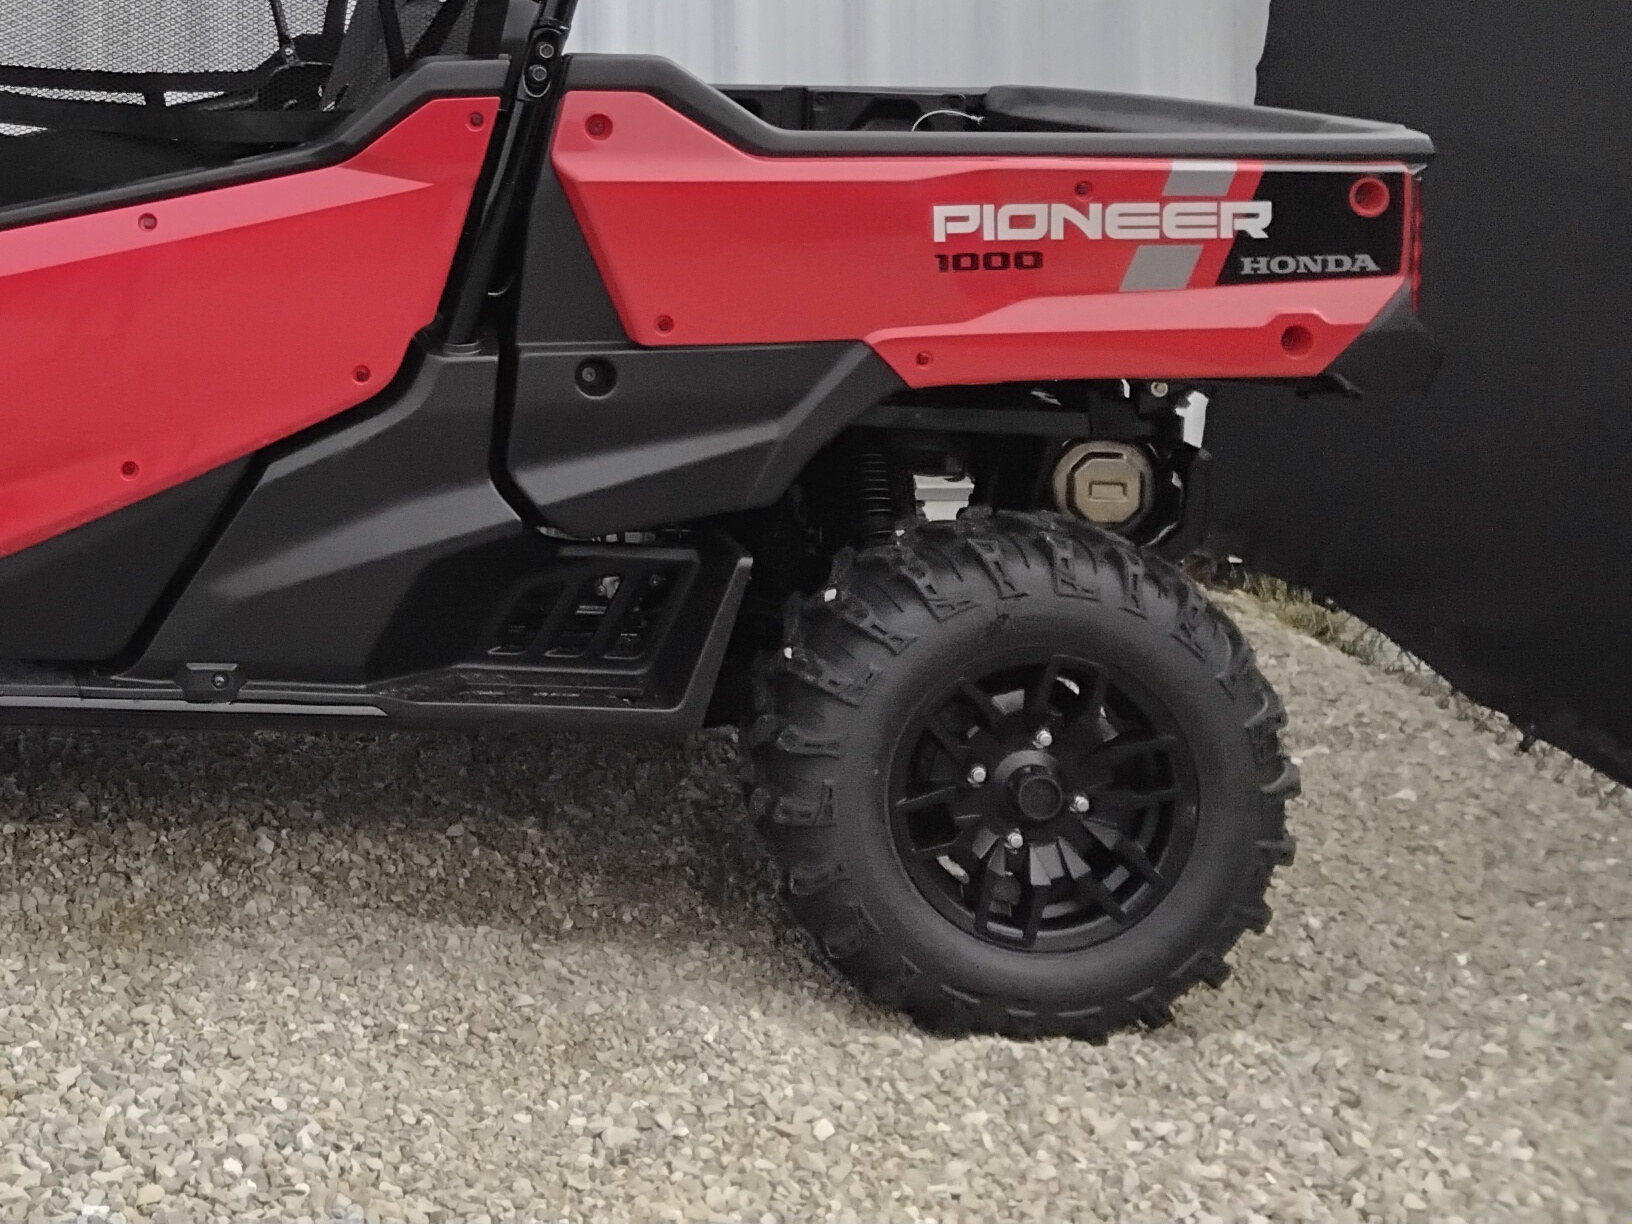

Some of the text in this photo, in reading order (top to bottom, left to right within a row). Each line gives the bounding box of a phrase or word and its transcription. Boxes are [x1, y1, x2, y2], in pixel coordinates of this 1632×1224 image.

[933, 200, 1272, 242] PIONEER
[934, 250, 1043, 272] 1000
[1240, 253, 1380, 276] HONDA
